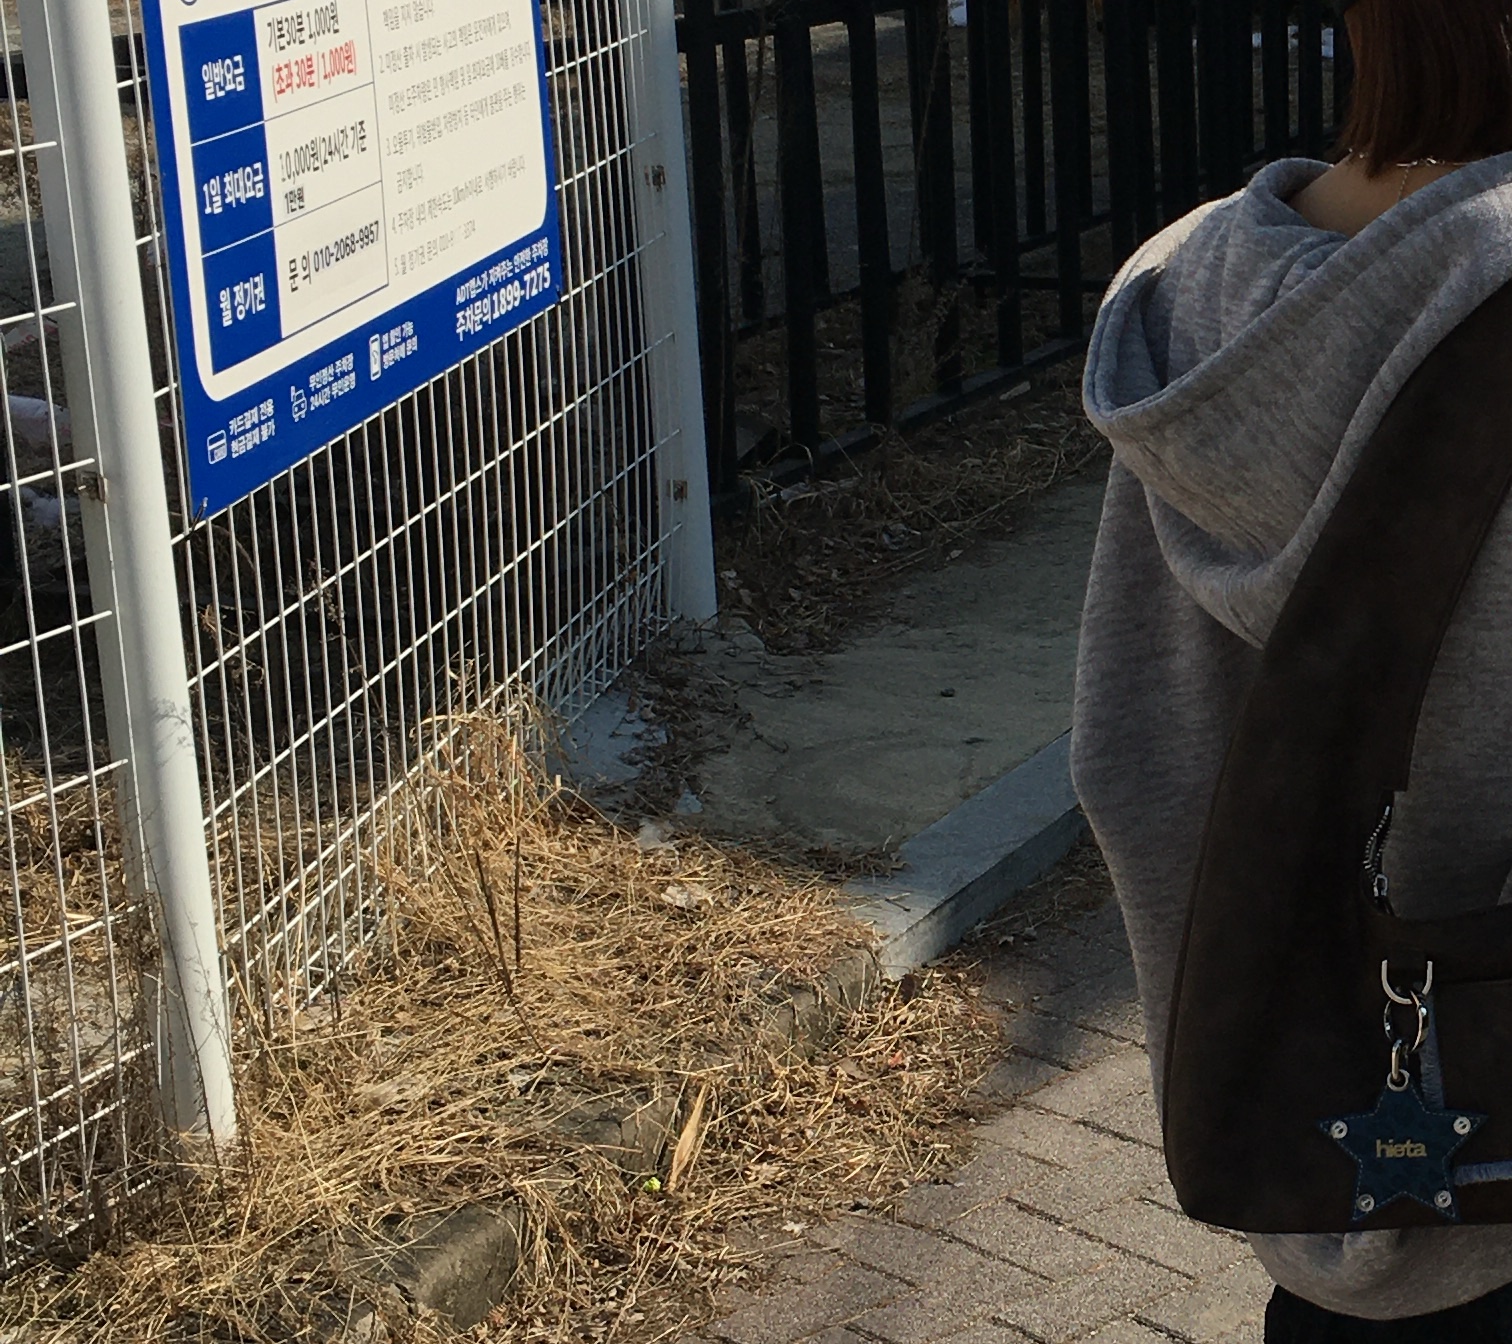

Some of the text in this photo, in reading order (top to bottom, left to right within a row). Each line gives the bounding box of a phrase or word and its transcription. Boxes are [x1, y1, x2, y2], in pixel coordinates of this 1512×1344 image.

[267, 0, 340, 53] 기본30분 1,000원
[202, 54, 245, 101] 일반요금
[271, 58, 294, 103] (초과
[294, 53, 315, 89] 30분
[322, 40, 357, 85] 1,000원)
[350, 120, 367, 154] 기준
[203, 161, 264, 215] 1일 최대요금
[284, 186, 305, 214] 1만원
[313, 220, 380, 273] 010-2068-9957
[531, 237, 549, 263] 주차장
[219, 272, 266, 327] 월 정기권
[456, 261, 551, 342] 주차문의 1899-7275
[228, 406, 259, 436] 카드결제
